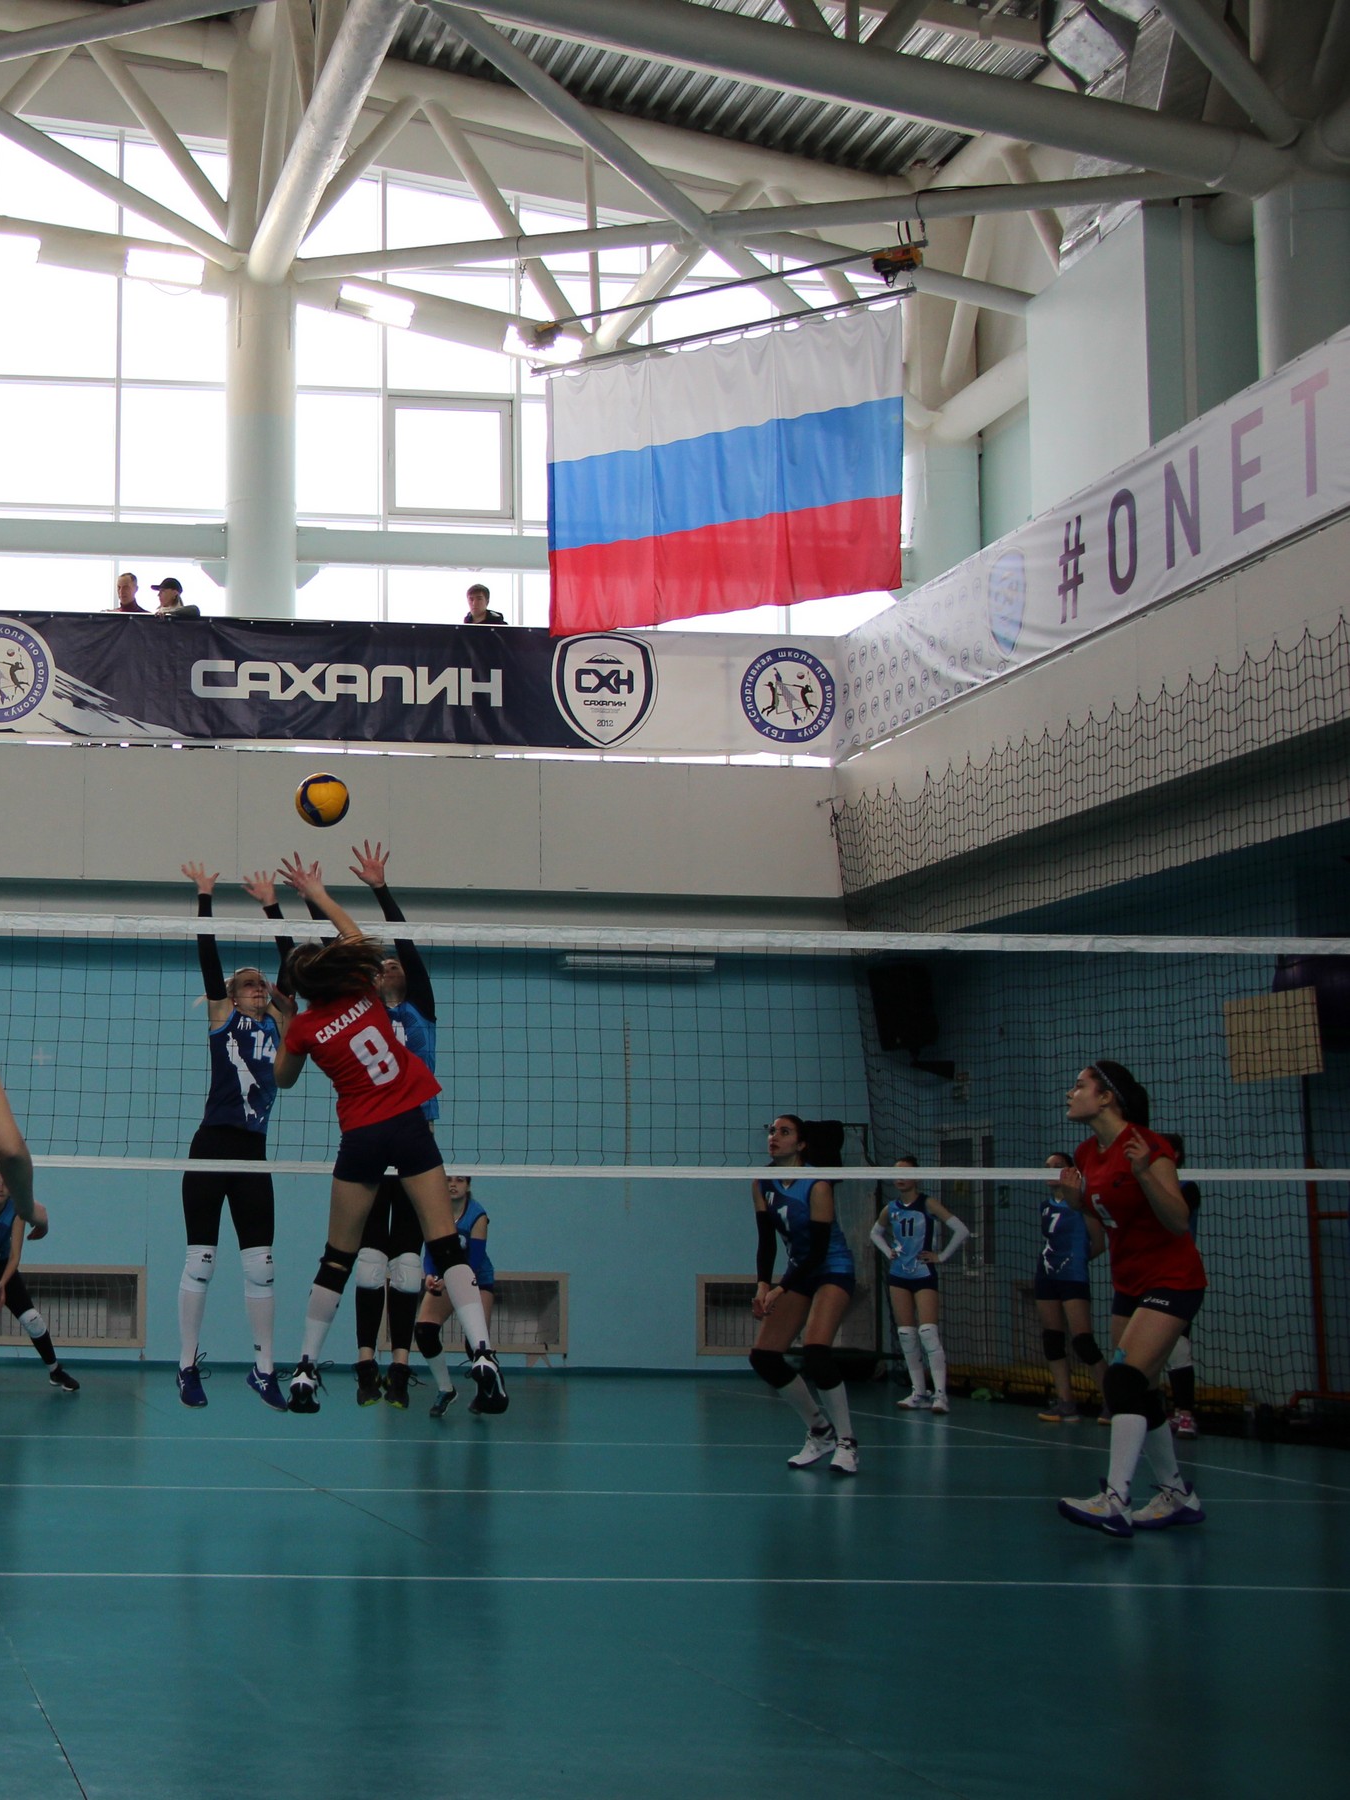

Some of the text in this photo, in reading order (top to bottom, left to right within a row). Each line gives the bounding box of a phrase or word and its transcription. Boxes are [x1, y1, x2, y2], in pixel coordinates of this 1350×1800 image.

[27, 642, 39, 656] по
[191, 659, 503, 708] САХАЛИН
[763, 726, 785, 740] ГБУ
[778, 650, 813, 665] школа
[815, 666, 827, 680] по
[583, 699, 626, 707] САХАЛИН
[597, 719, 614, 727] 2012
[315, 996, 374, 1044] САХАЛИН
[348, 1025, 400, 1087] 8
[899, 1217, 915, 1237] 11
